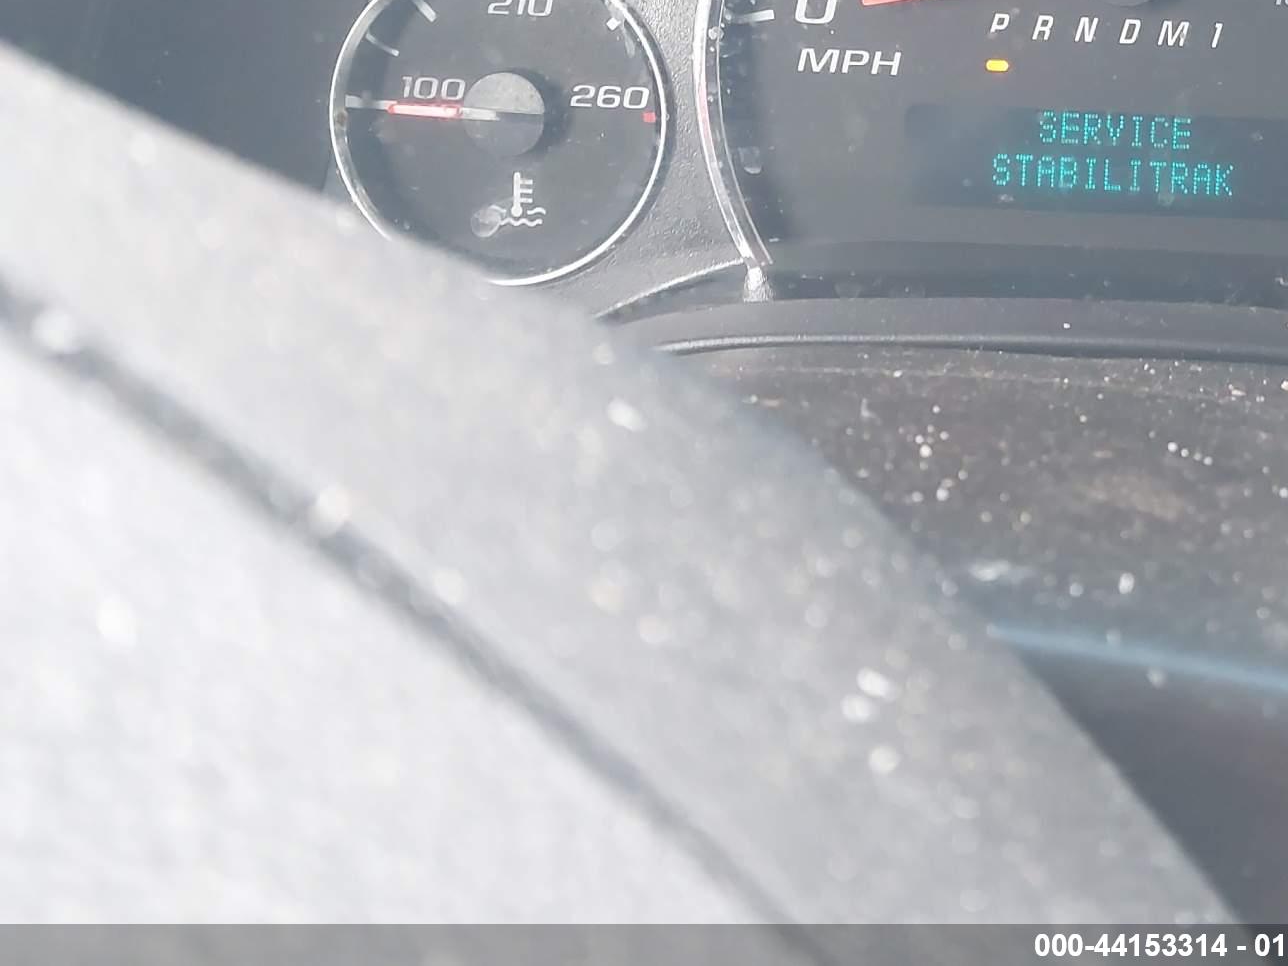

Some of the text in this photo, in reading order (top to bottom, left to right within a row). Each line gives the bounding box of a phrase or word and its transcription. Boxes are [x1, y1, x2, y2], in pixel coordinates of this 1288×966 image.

[990, 13, 1223, 48] P R N D M 1
[797, 47, 902, 76] MPH
[400, 75, 466, 101] 100
[569, 84, 650, 110] 260
[1038, 110, 1192, 150] SERVICE
[991, 153, 1235, 196] STABILITRAK
